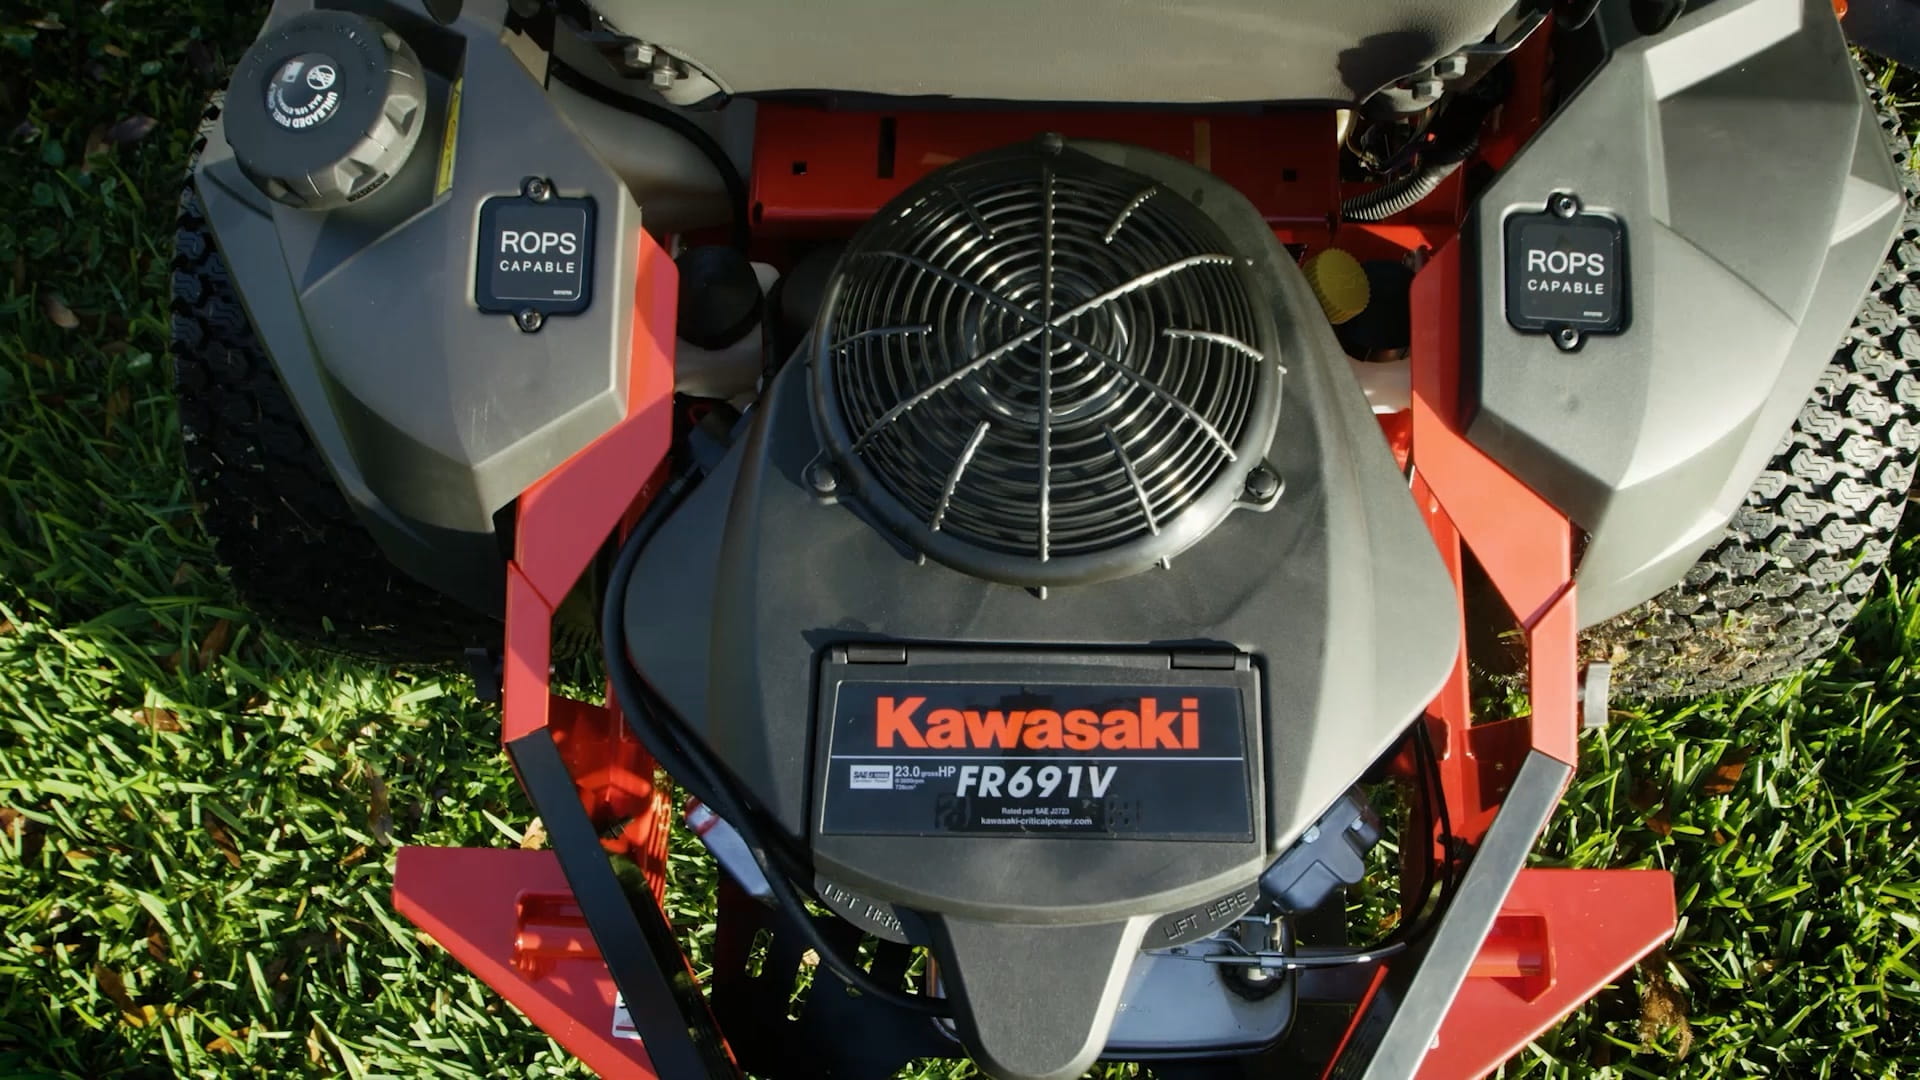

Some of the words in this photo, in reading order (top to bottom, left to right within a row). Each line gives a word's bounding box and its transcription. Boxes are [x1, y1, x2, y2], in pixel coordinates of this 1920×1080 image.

[292, 91, 338, 128] UNLEADED
[308, 94, 323, 110] MAX
[273, 108, 291, 127] FUEL
[501, 231, 576, 254] ROPS
[499, 260, 575, 273] CAPABLE
[1527, 249, 1605, 276] ROPS
[1527, 279, 1605, 295] CAPABLE
[876, 697, 1199, 749] Kawasaki
[894, 765, 920, 778] 23.0
[956, 765, 1118, 798] FR691V
[980, 816, 1093, 826] kawasaki-criticalpower.com
[1001, 807, 1021, 815] Rated
[1022, 808, 1033, 816] per
[1034, 807, 1048, 815] SAE
[824, 883, 860, 910] LIFT
[1163, 914, 1198, 940] LIFT
[1205, 891, 1251, 921] HERE
